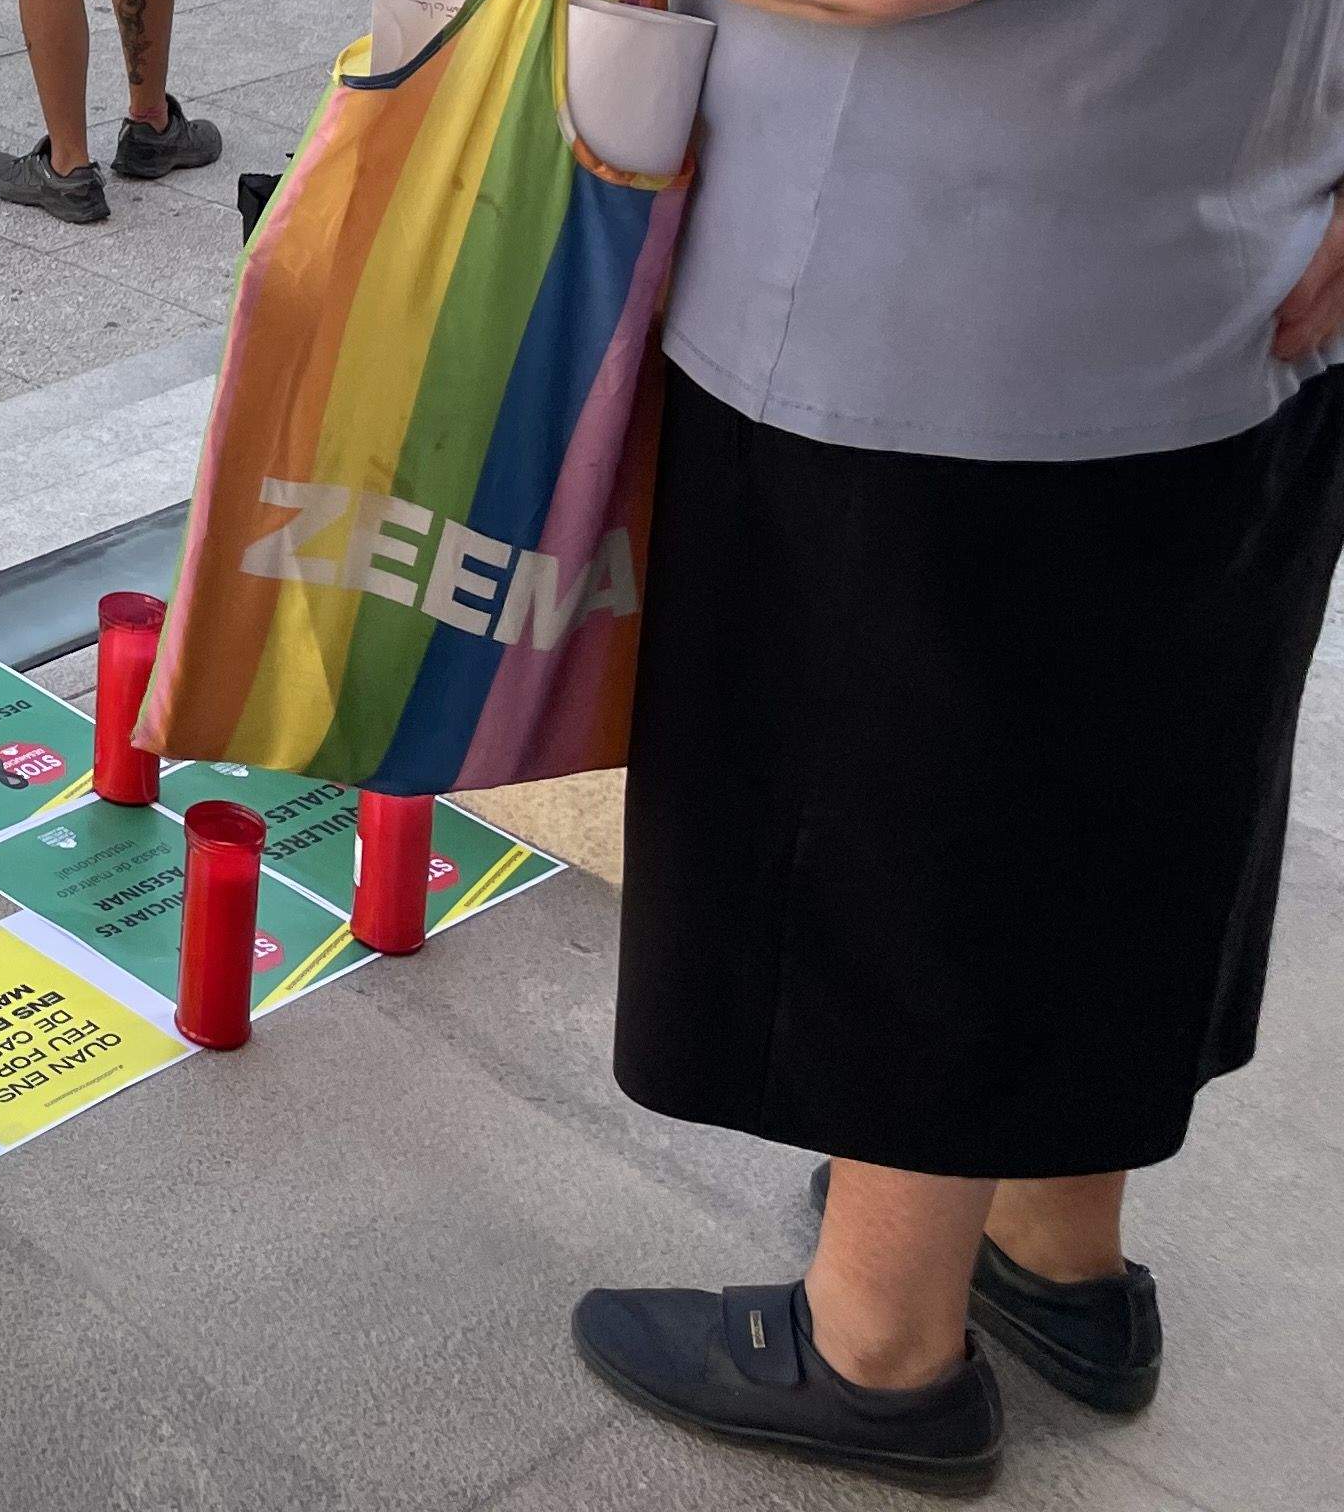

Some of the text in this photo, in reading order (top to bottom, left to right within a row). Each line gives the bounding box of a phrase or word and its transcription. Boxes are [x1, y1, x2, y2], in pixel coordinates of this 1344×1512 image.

[264, 784, 347, 824] CIALES
[92, 865, 185, 913] ASESINAR
[94, 921, 123, 939] ES
[11, 990, 65, 1019] ENS
[34, 1009, 73, 1033] DE
[48, 1019, 100, 1051] FEU
[48, 1033, 122, 1075] QUAN
